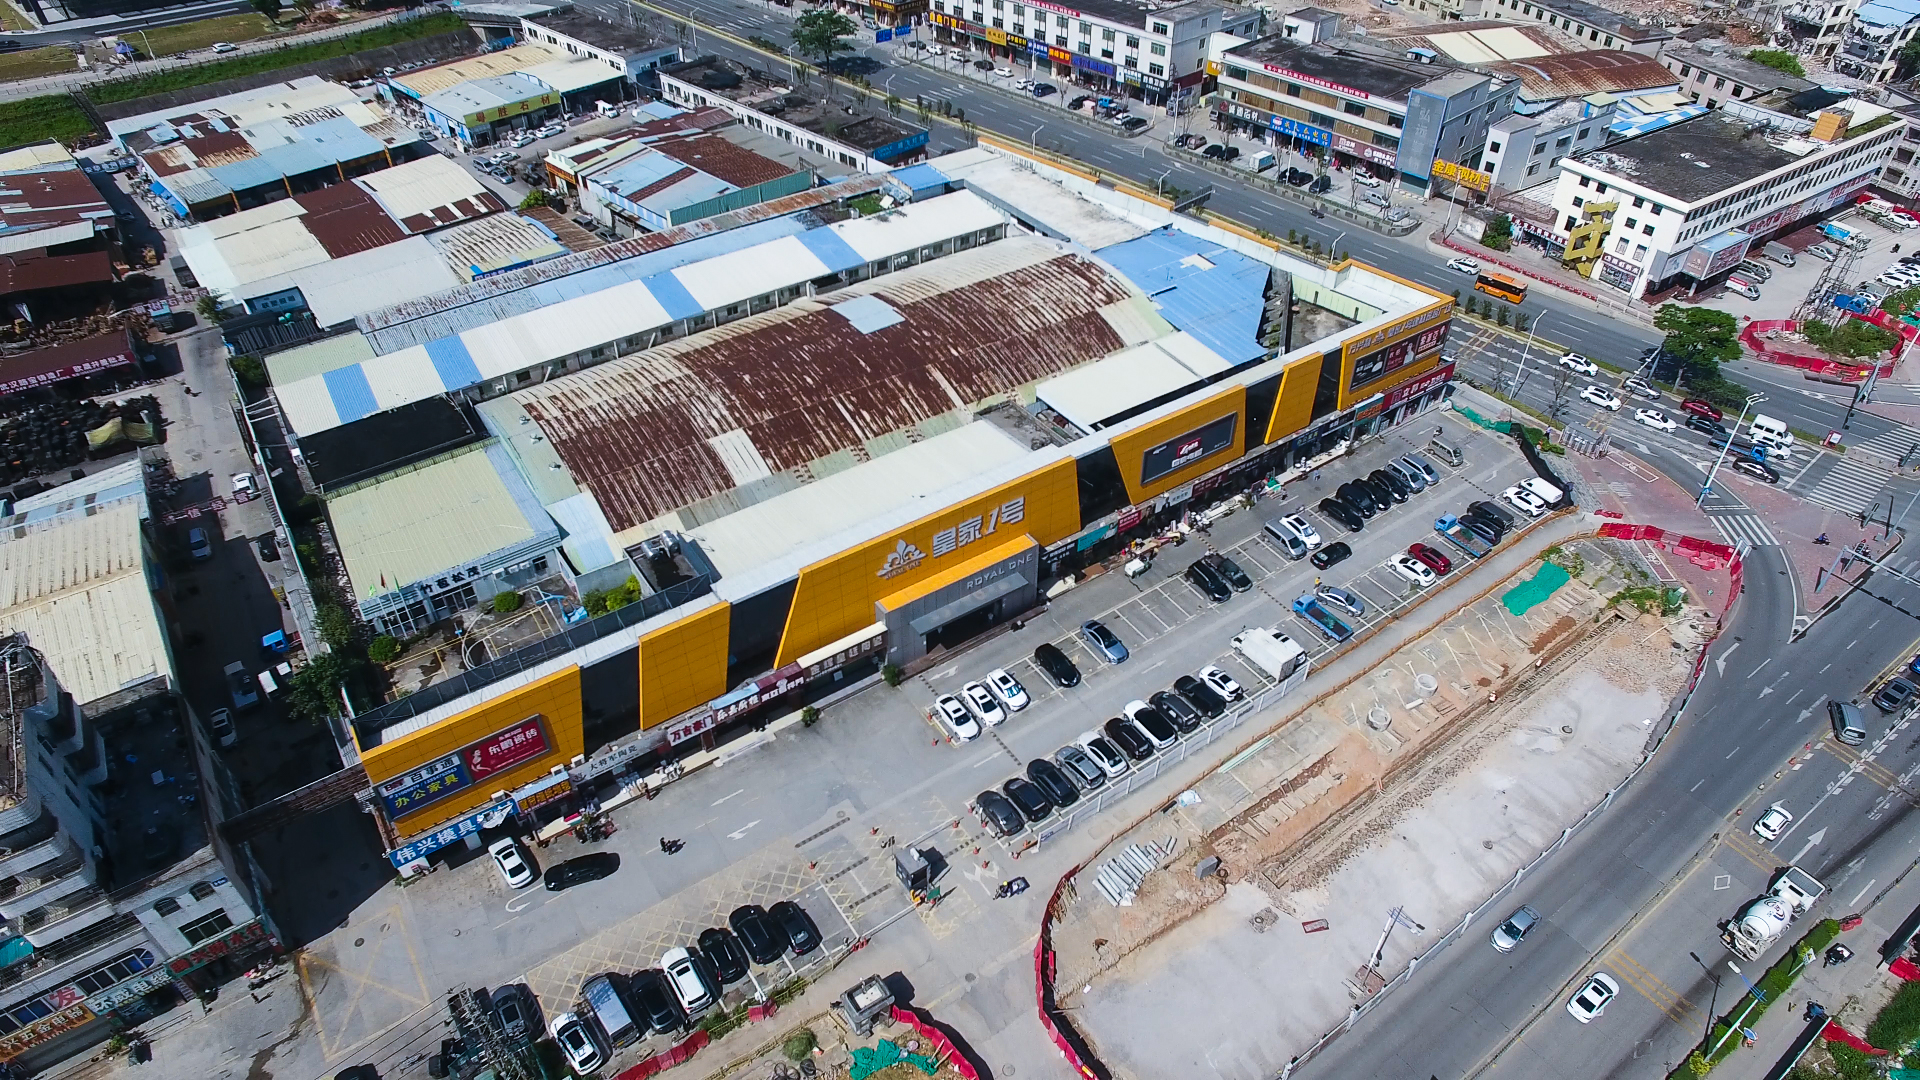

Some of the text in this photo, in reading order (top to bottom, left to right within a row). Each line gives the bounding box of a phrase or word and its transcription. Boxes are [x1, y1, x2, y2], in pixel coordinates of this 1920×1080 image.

[932, 495, 1026, 559] 皇家1号
[966, 553, 1034, 590] ROYAL ONE
[411, 757, 455, 783] 百事通
[588, 744, 638, 772] 大将军陶瓷
[395, 773, 459, 809] 办公家具
[49, 986, 85, 1010] 发
